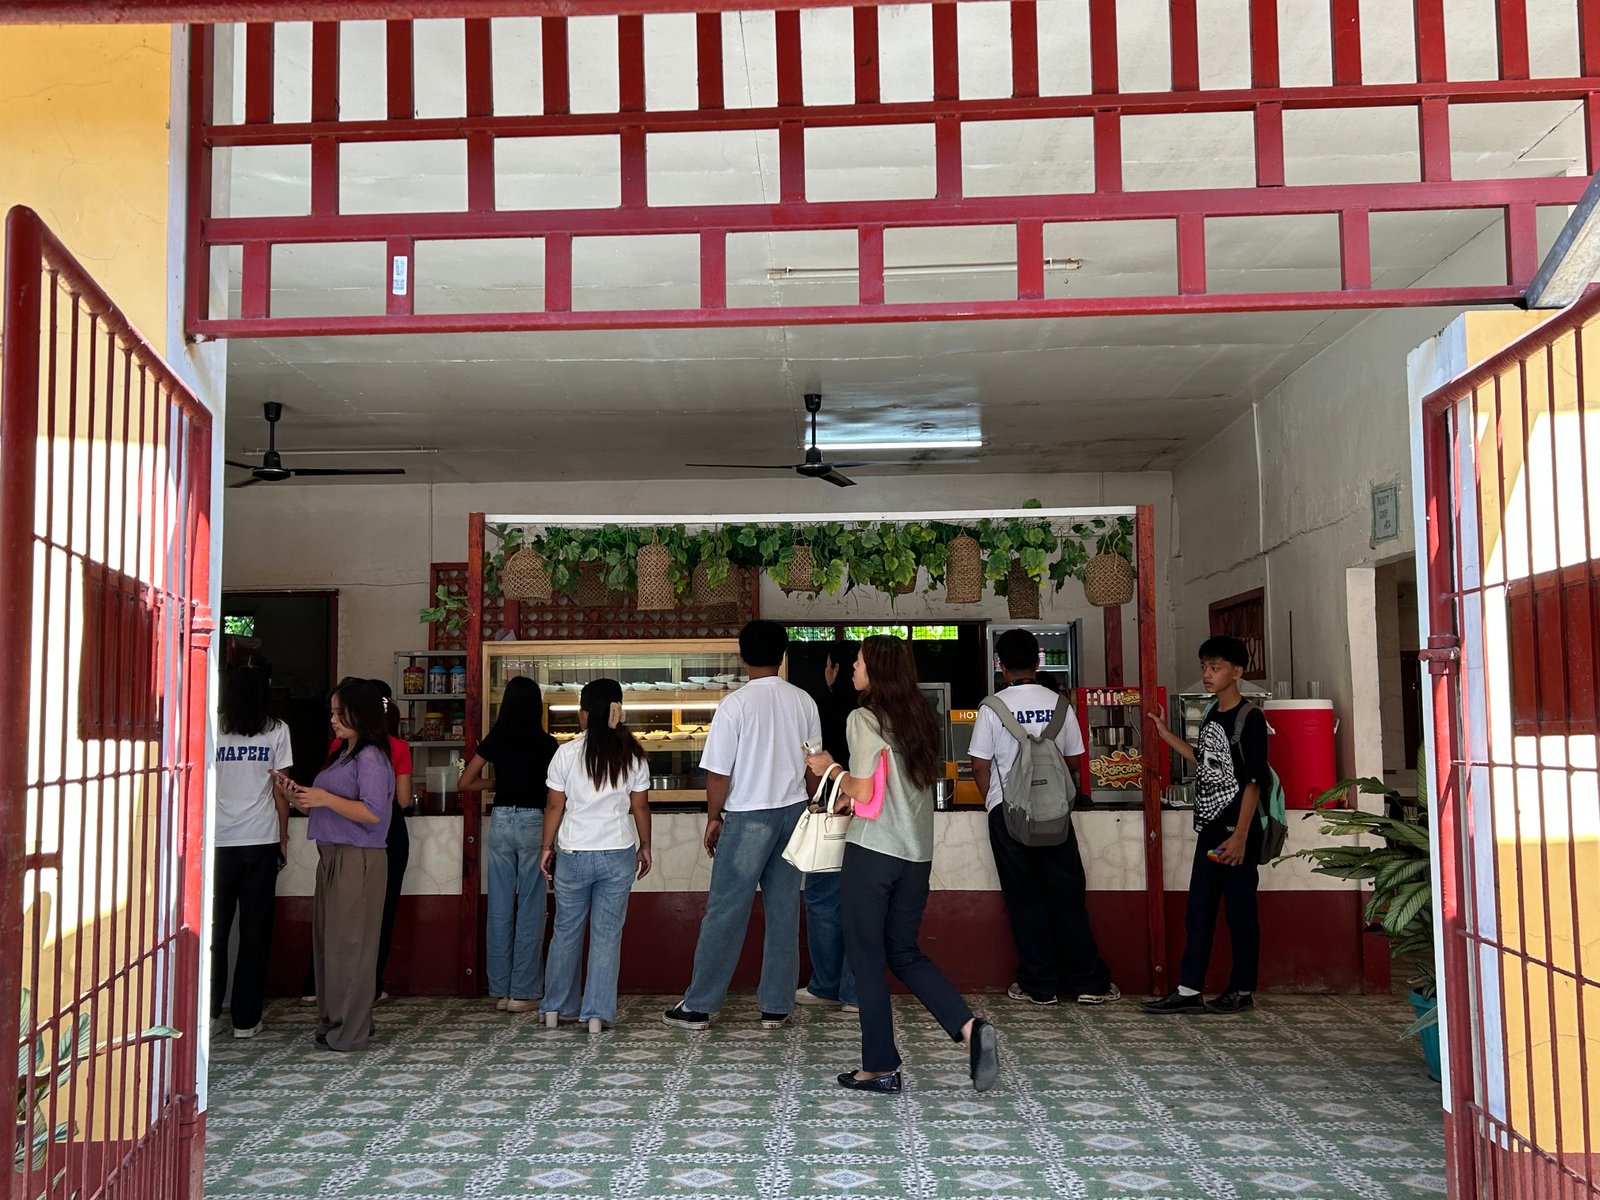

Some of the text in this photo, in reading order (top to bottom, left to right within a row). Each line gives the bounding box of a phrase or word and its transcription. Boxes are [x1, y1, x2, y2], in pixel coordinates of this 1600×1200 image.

[959, 711, 978, 719] HOT
[1010, 709, 1055, 724] APEH
[216, 745, 270, 762] MAPEH
